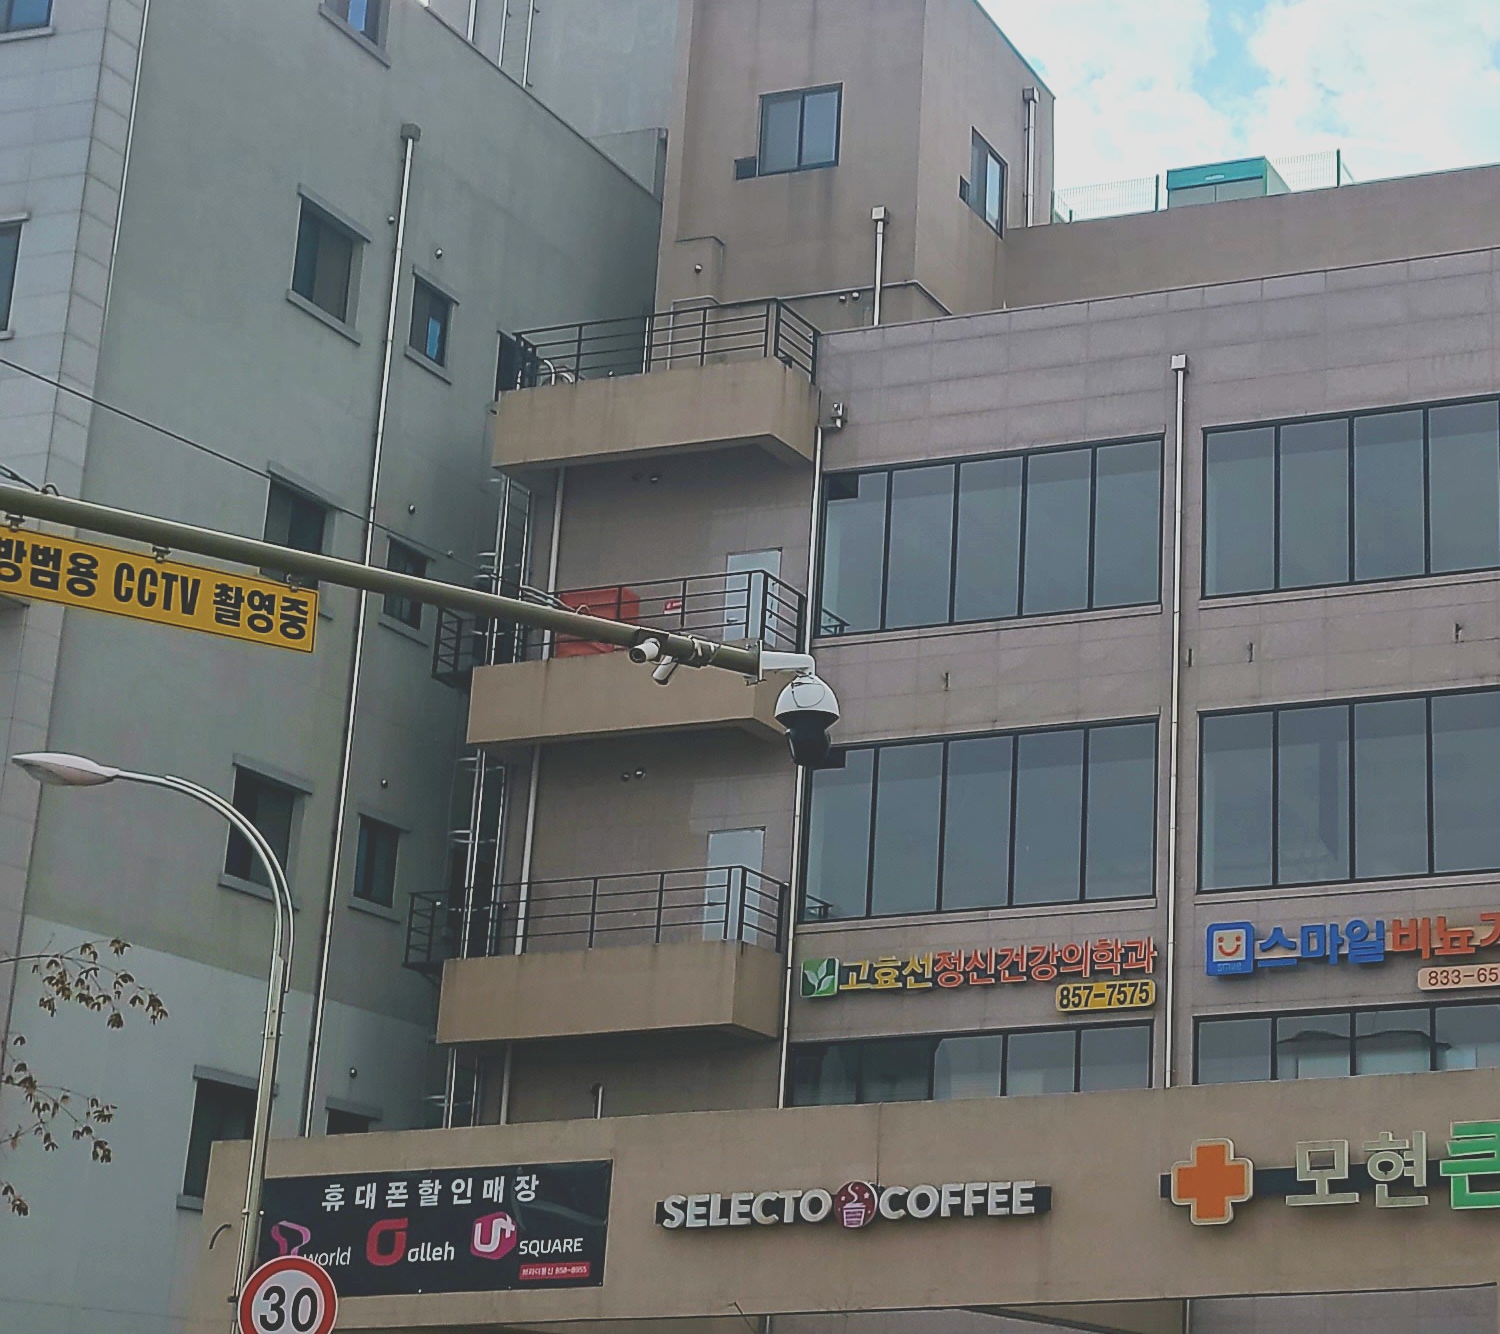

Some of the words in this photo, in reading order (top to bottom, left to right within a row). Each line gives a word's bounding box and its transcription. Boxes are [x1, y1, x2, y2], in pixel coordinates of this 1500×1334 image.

[0, 537, 99, 598] 방범용
[113, 562, 201, 616] CCTV
[213, 582, 309, 641] 촬영중
[1060, 982, 1151, 1008] 857-7575
[662, 1188, 833, 1229] SELECTO
[879, 1180, 1037, 1220] COFFEE
[407, 1242, 455, 1263] olleh
[519, 1238, 584, 1258] SQUARE
[259, 1284, 318, 1333] 30
